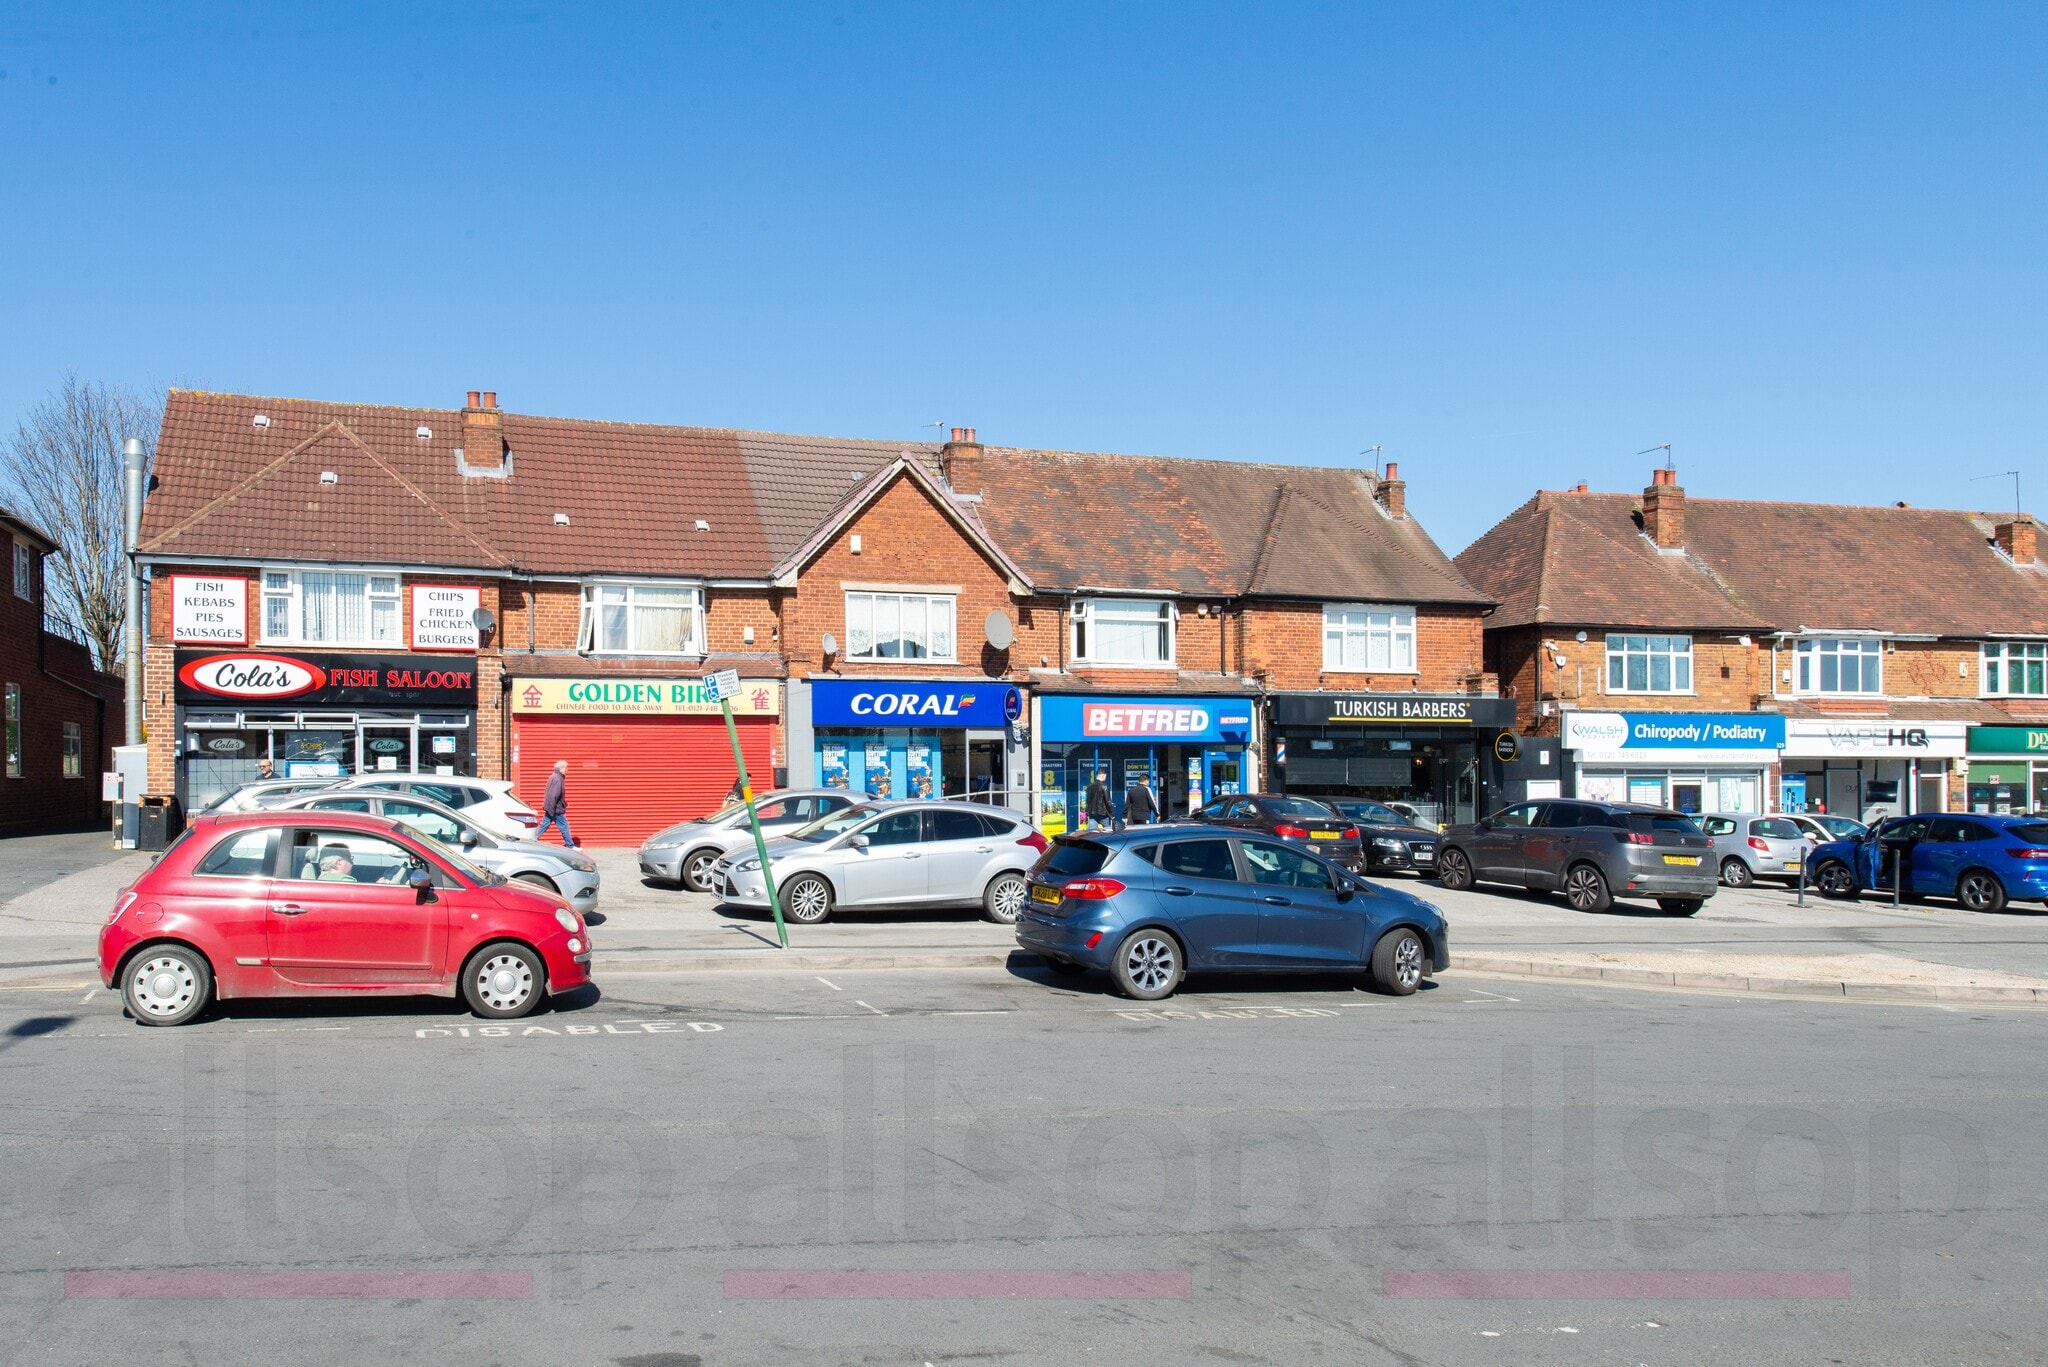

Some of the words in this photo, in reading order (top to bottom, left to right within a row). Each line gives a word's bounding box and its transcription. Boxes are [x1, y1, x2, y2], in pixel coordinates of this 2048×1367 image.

[195, 582, 224, 592] FISH
[184, 597, 235, 608] KEBABS
[428, 592, 464, 602] CHIPS
[196, 612, 224, 623] PIES
[429, 608, 464, 618] FRIED
[419, 619, 473, 629] CHICKEN
[176, 627, 243, 639] SAUSAGES
[418, 634, 475, 645] BURGERS
[215, 663, 292, 688] Cola's
[330, 668, 379, 688] FISH
[386, 669, 472, 689] SALOON
[522, 684, 543, 708] 金
[568, 683, 662, 703] GOLDEN
[671, 684, 721, 704] BIR
[556, 703, 586, 711] CHINESE
[850, 693, 959, 716] CORAL
[1334, 701, 1398, 717] TURKISH
[1402, 702, 1466, 718] BARBERS
[1088, 709, 1209, 732] BETFRED
[1220, 717, 1249, 725] BETFRED
[1578, 725, 1623, 735] WALSH
[1634, 724, 1701, 742] Chiropody
[1713, 724, 1766, 742] Podiatry
[214, 740, 241, 749] Cola's
[1044, 770, 1055, 786] 8
[415, 1021, 725, 1039] DISABLED
